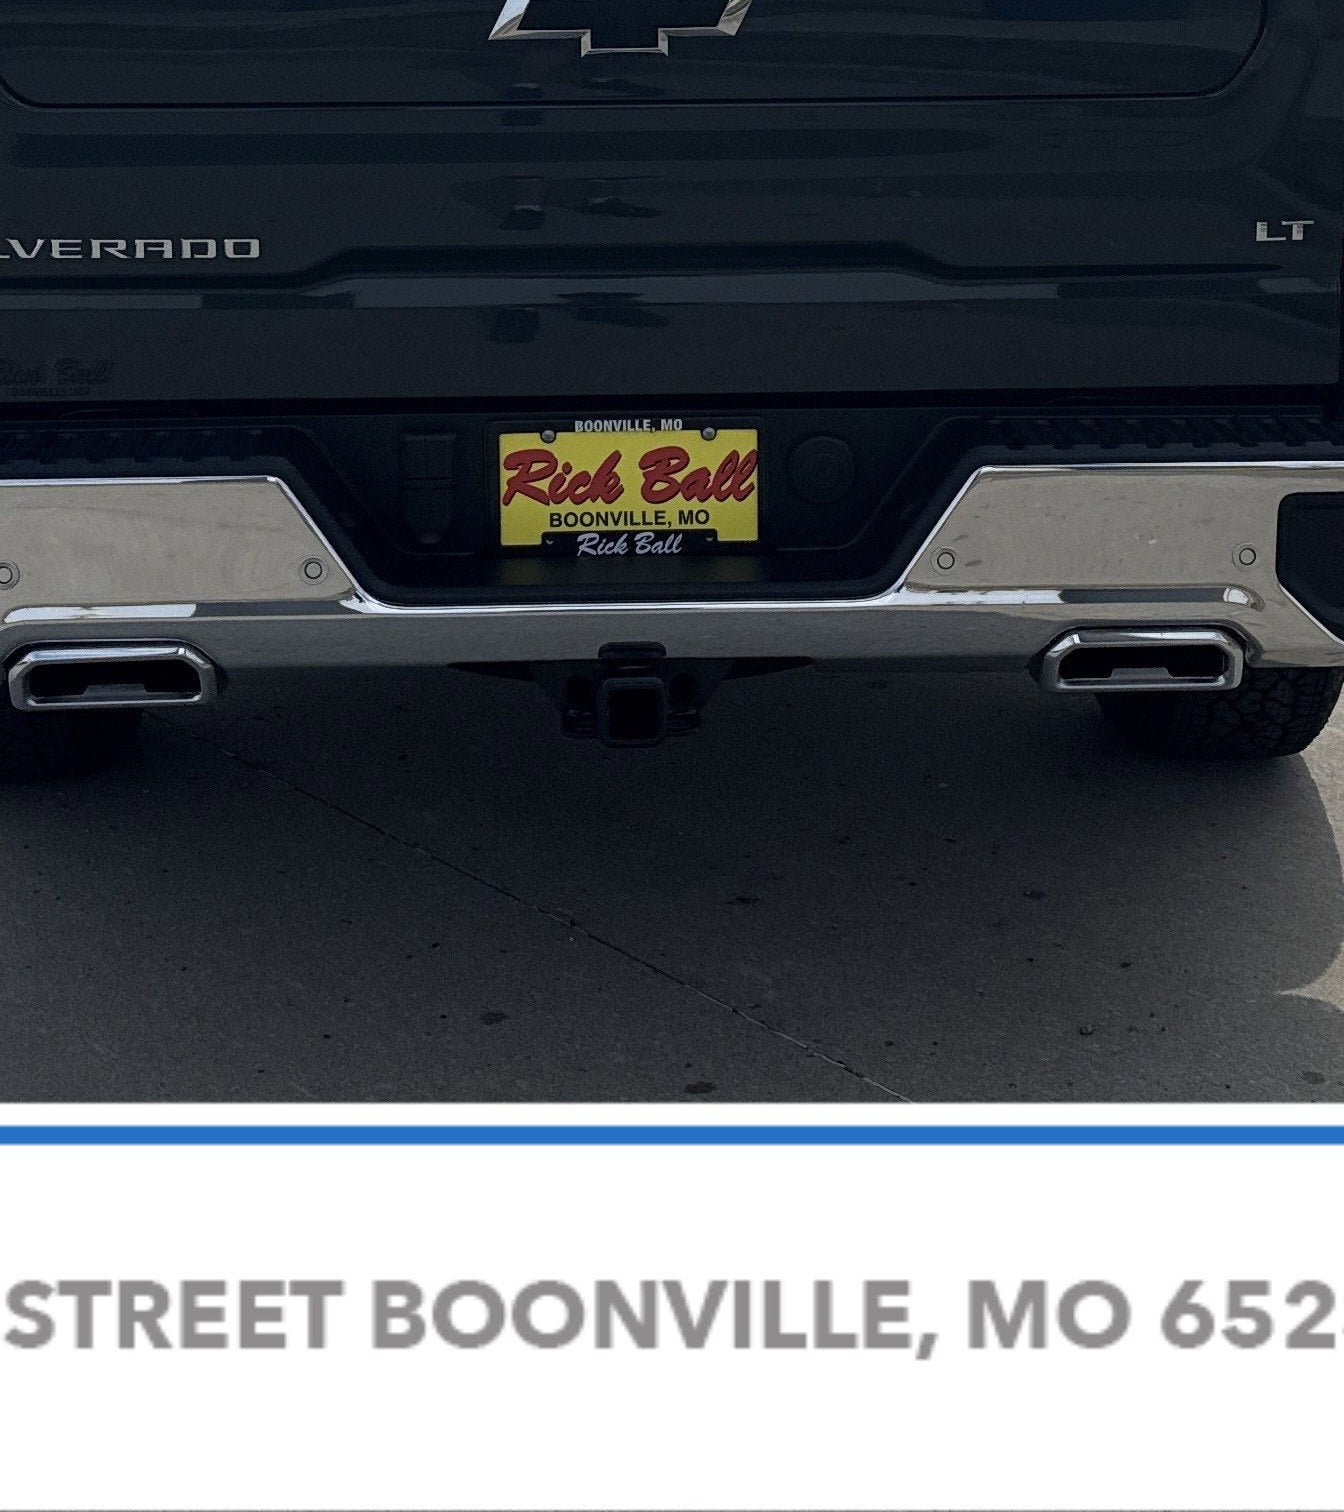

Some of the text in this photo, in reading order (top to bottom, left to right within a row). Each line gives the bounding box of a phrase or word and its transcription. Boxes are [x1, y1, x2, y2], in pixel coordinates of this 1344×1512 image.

[1255, 220, 1315, 242] LT
[574, 418, 683, 432] BOONVILLE, MO
[502, 446, 758, 506] Rick Ball
[549, 509, 710, 528] BOONVILLE, MO
[577, 531, 683, 557] Rick Ball
